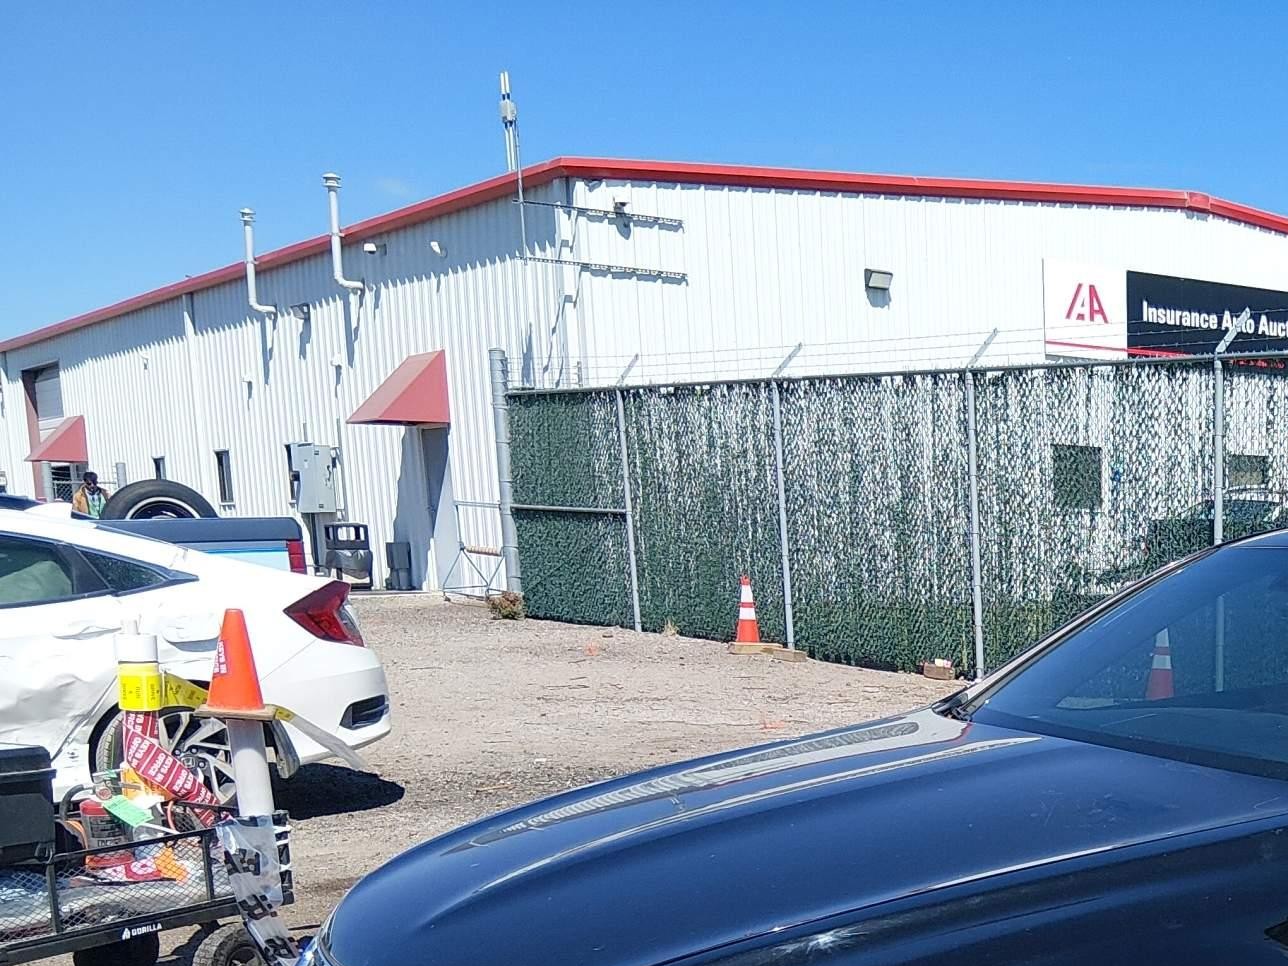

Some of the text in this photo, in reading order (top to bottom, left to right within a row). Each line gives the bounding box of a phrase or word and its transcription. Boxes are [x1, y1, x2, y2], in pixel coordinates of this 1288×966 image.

[1142, 299, 1218, 330] Insurance
[147, 752, 166, 777] OFFICE
[160, 756, 174, 774] KEYS
[131, 922, 163, 937] GORILLA
